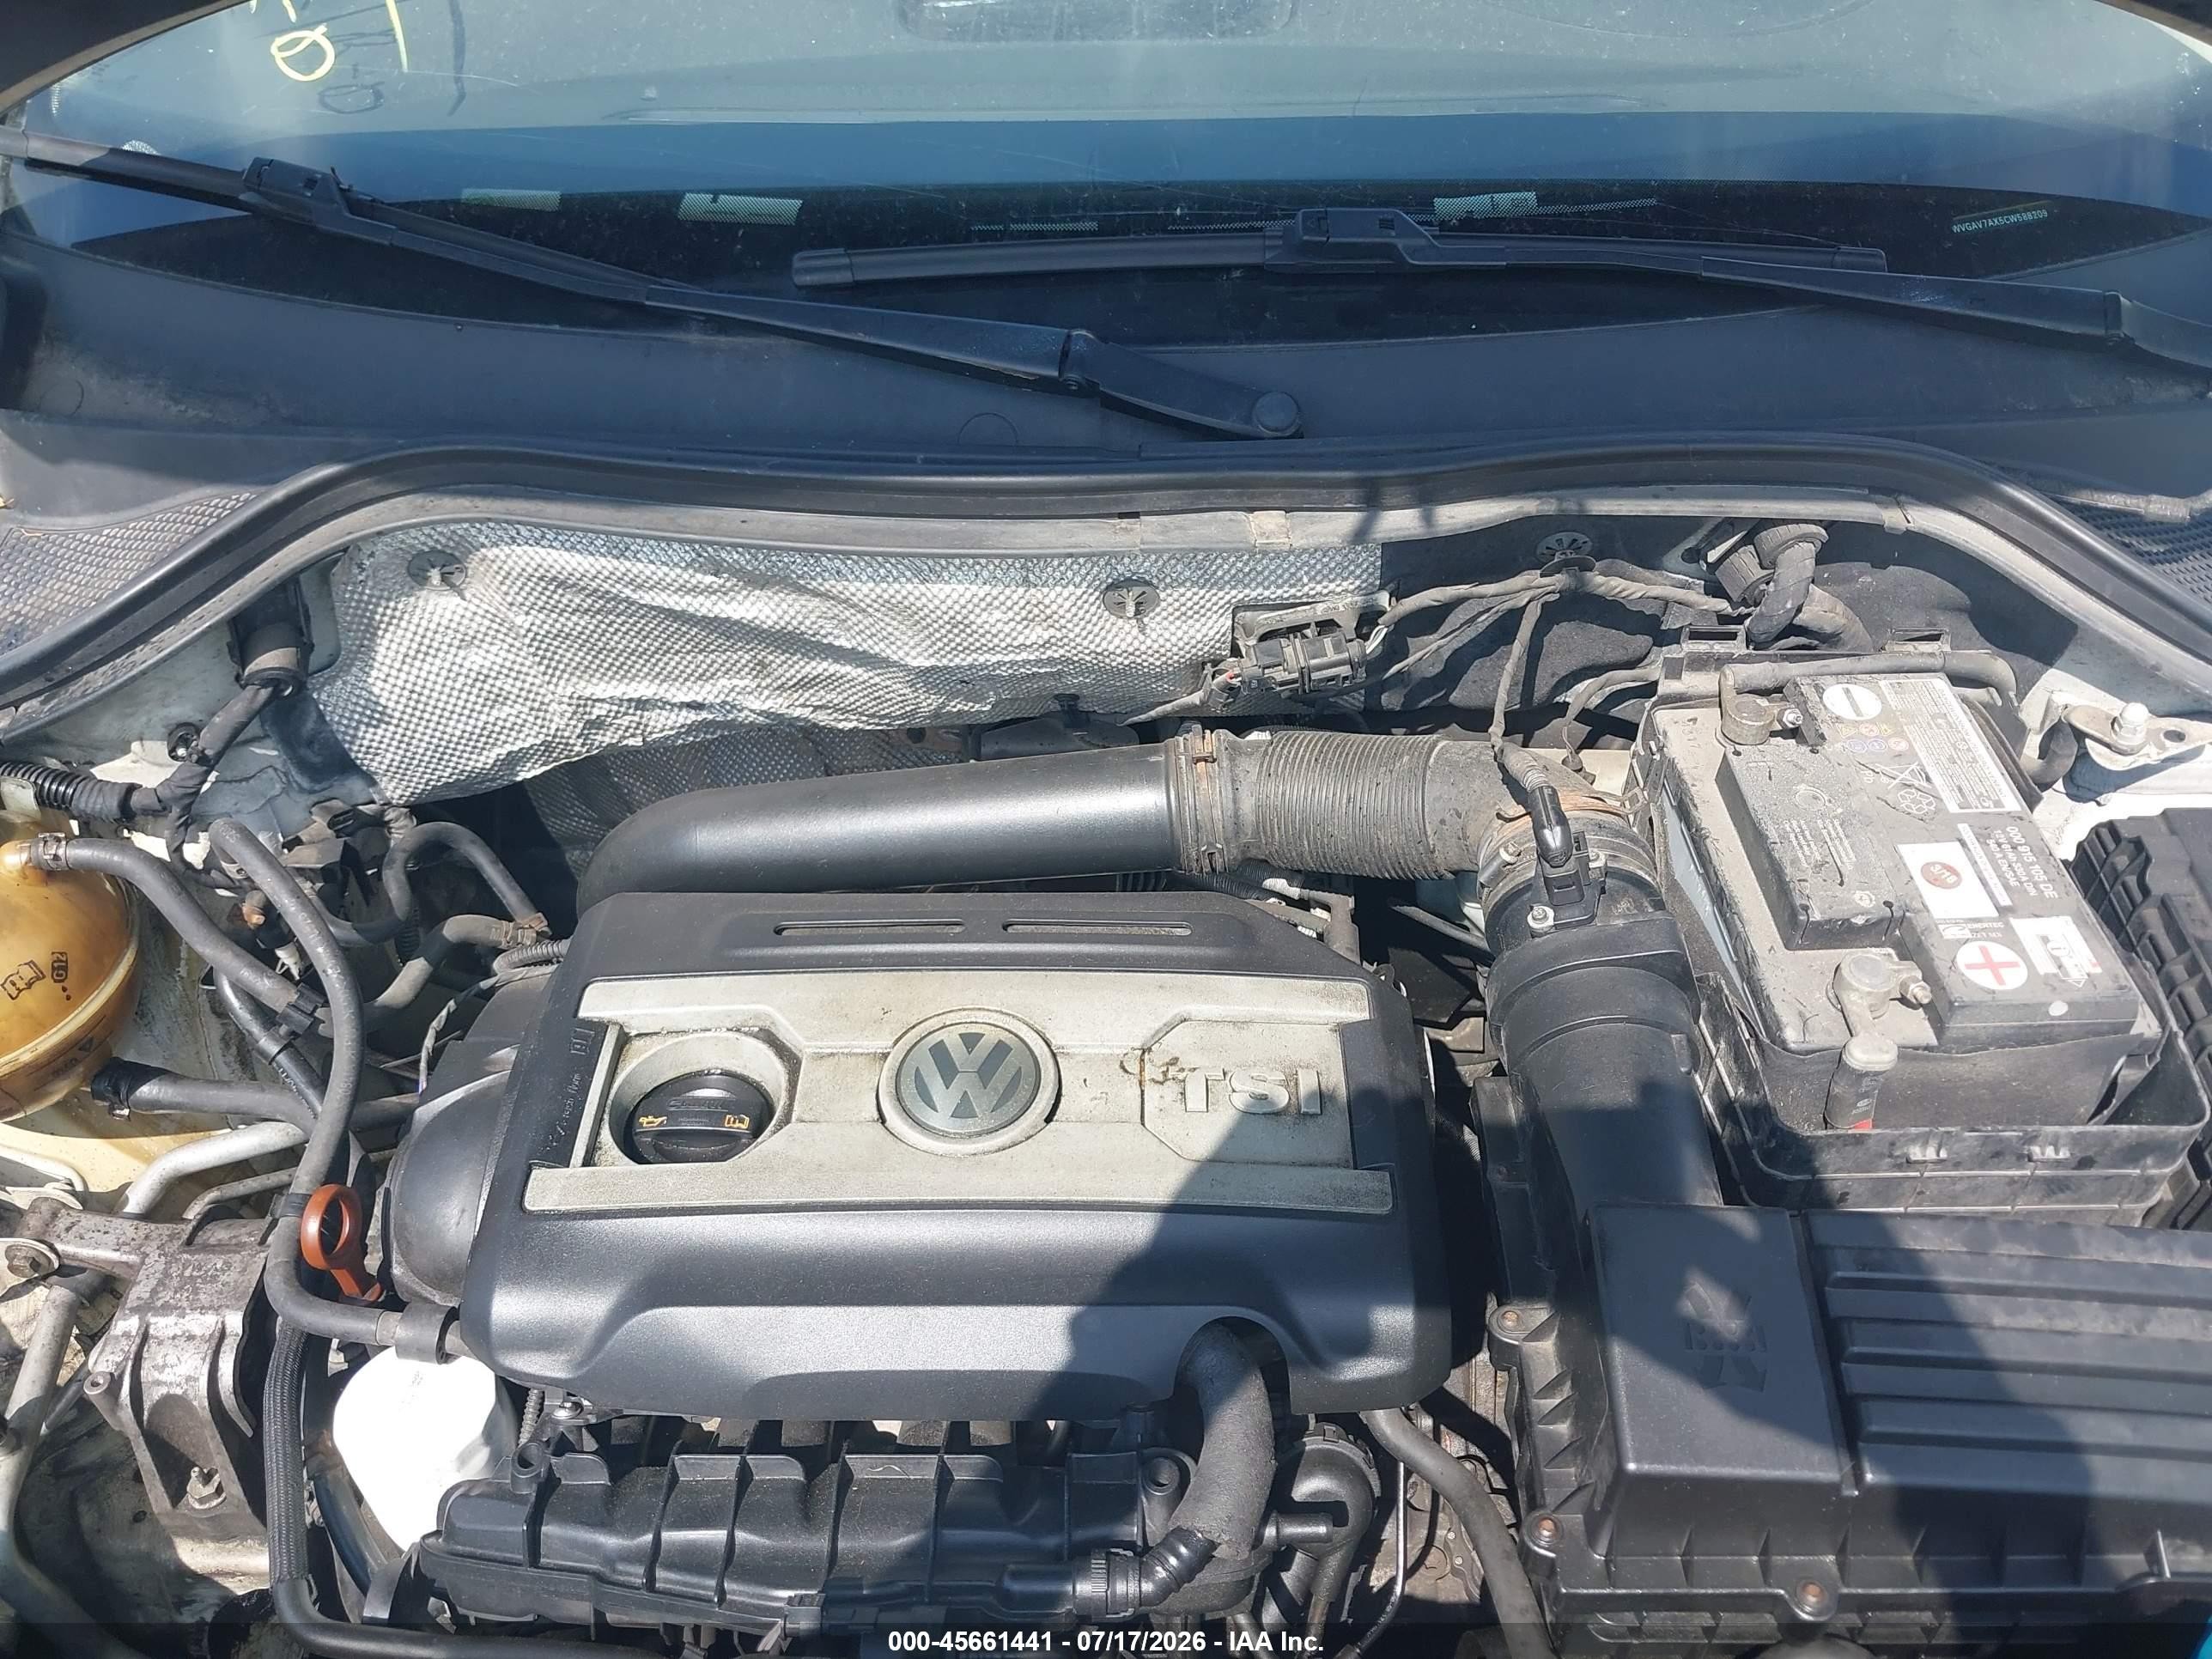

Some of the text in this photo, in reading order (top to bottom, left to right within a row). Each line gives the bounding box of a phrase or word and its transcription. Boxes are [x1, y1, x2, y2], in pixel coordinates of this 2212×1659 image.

[2006, 826, 2058, 898] 000 915 105 DE
[2023, 882, 2039, 896] DIN
[52, 951, 68, 983] G12
[906, 1026, 1032, 1128] VW
[1183, 1066, 1323, 1115] TSI
